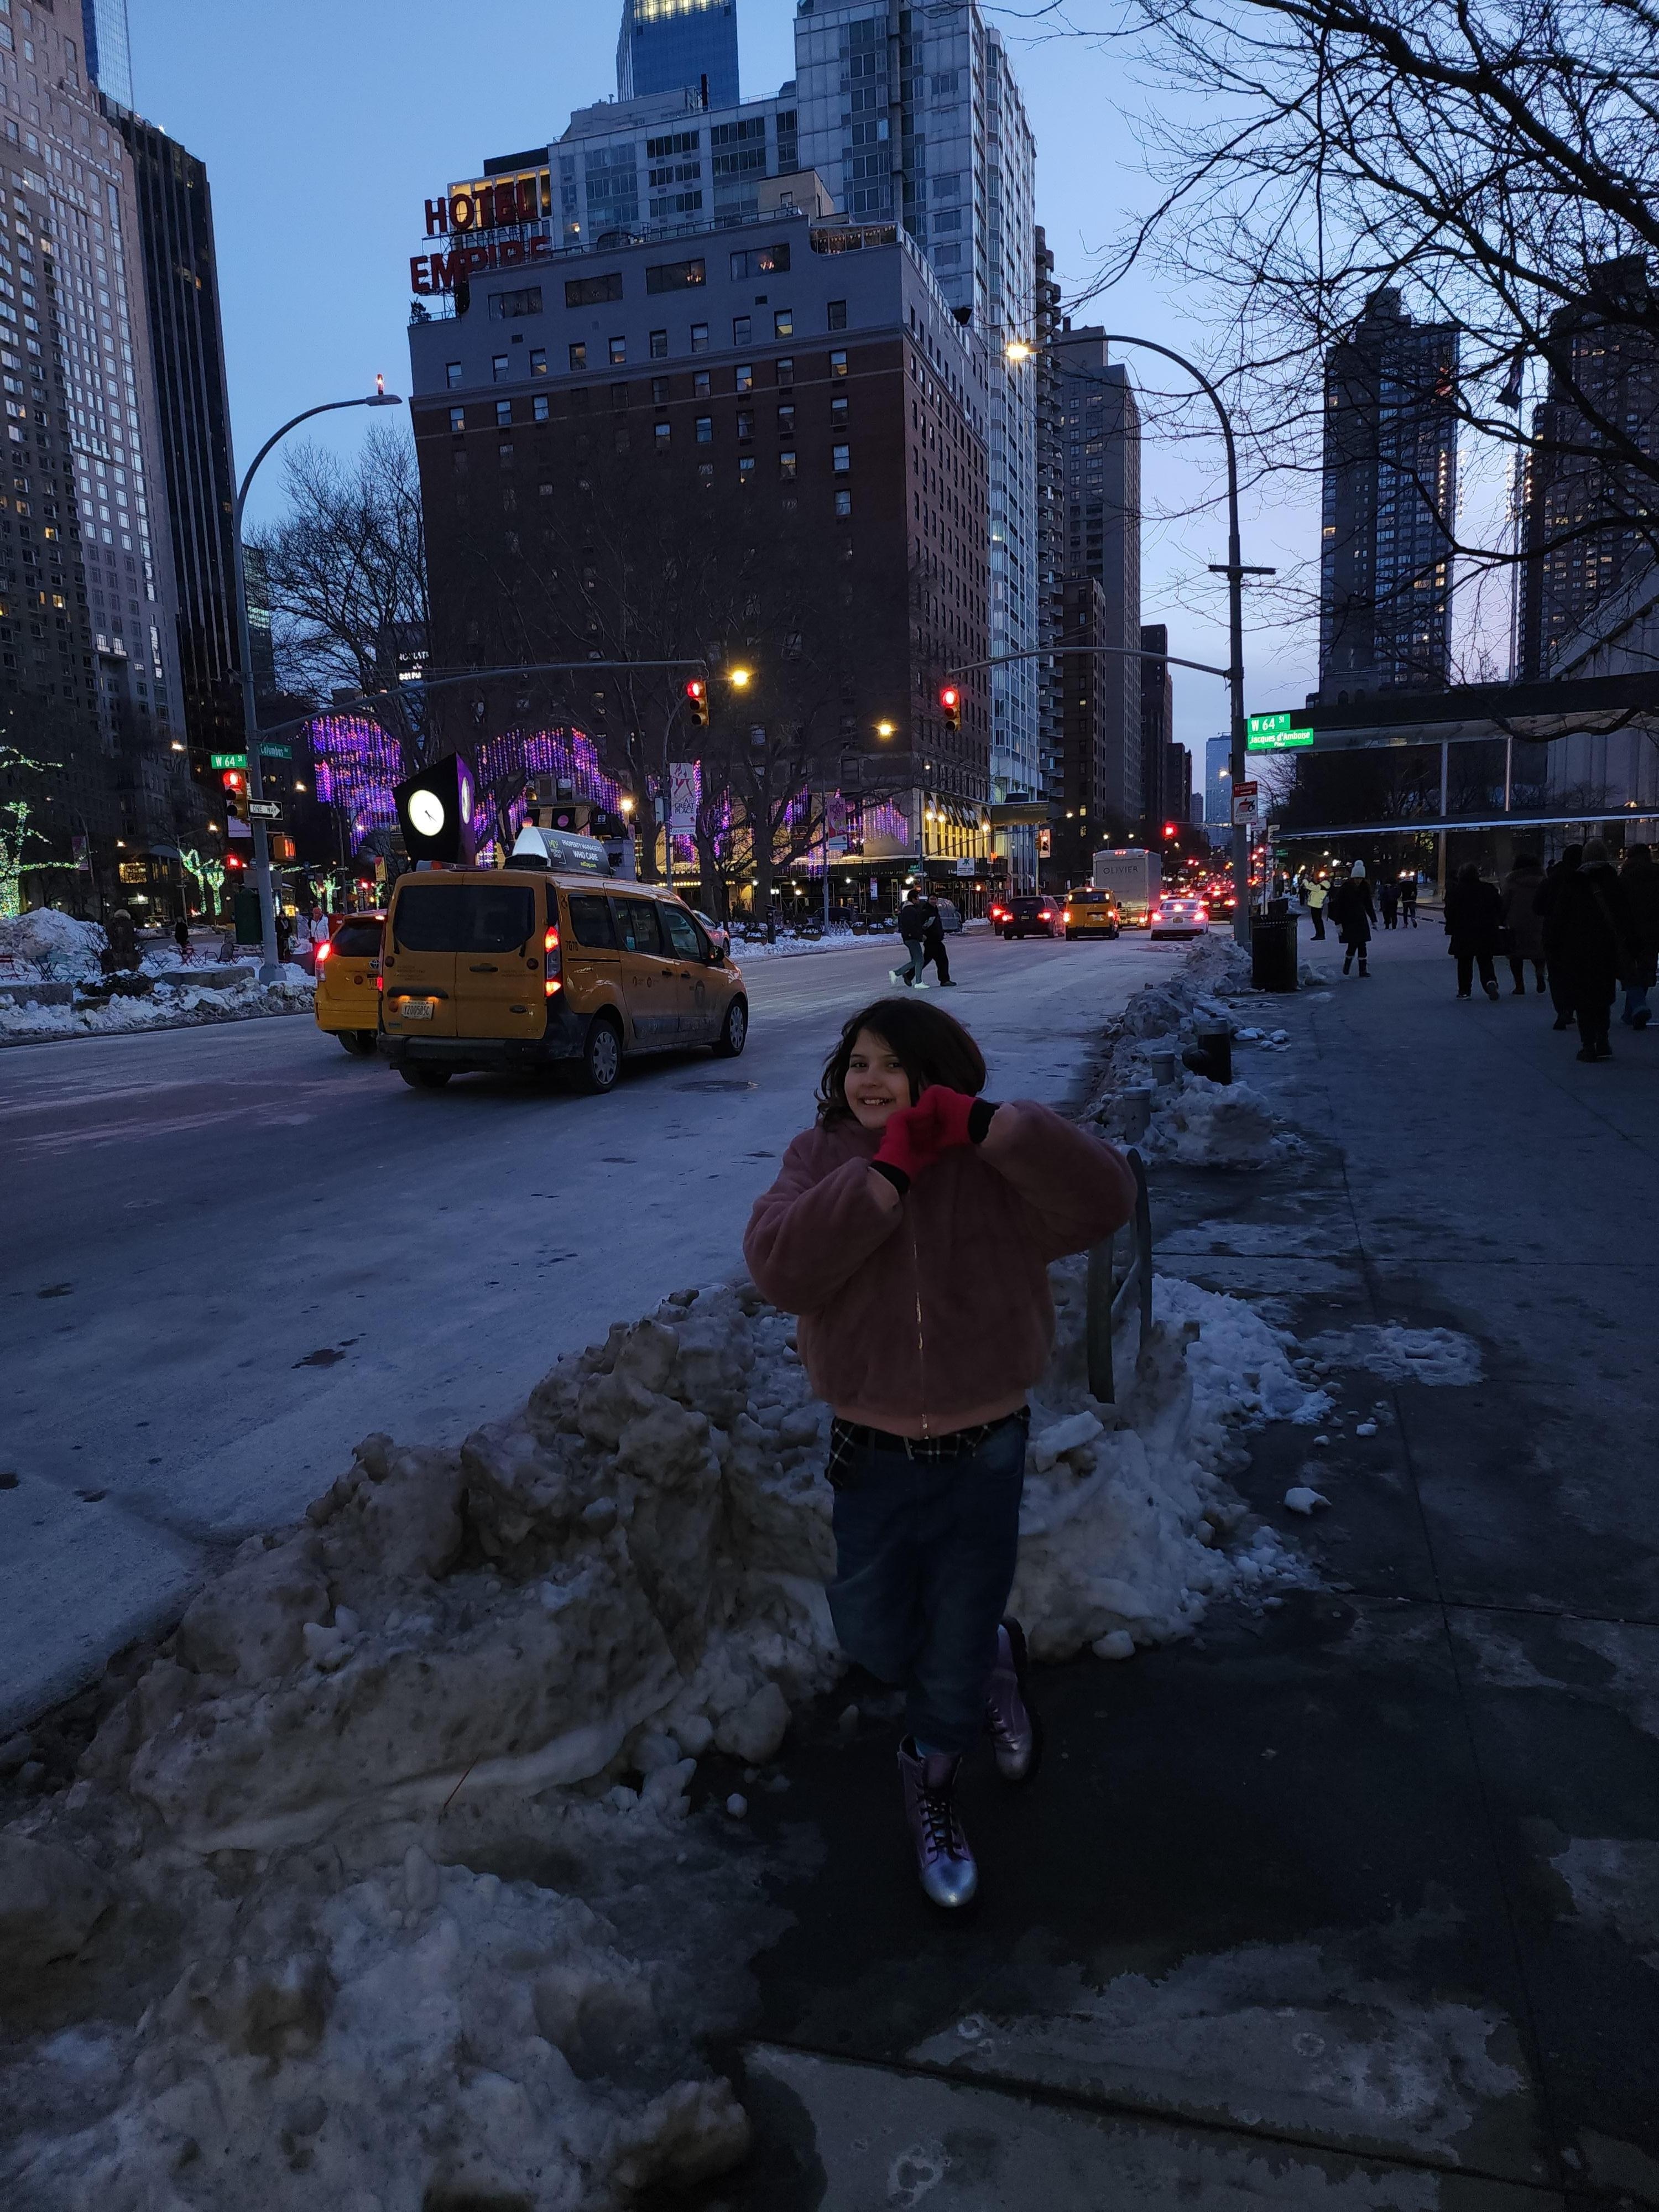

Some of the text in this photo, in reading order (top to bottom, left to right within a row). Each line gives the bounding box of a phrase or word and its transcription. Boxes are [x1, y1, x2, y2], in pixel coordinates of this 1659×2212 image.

[424, 180, 539, 236] HOTEL
[410, 236, 552, 293] EMPIRE
[1251, 719, 1259, 732] W
[1262, 717, 1275, 731] 64
[1249, 732, 1311, 744] Jacques d'Amboise
[260, 743, 284, 757] Columbus
[215, 756, 222, 767] W
[225, 756, 236, 767] 64
[561, 839, 582, 849] PROPERTY
[572, 849, 599, 861] WHO CARE
[1103, 866, 1138, 874] OLIVIER
